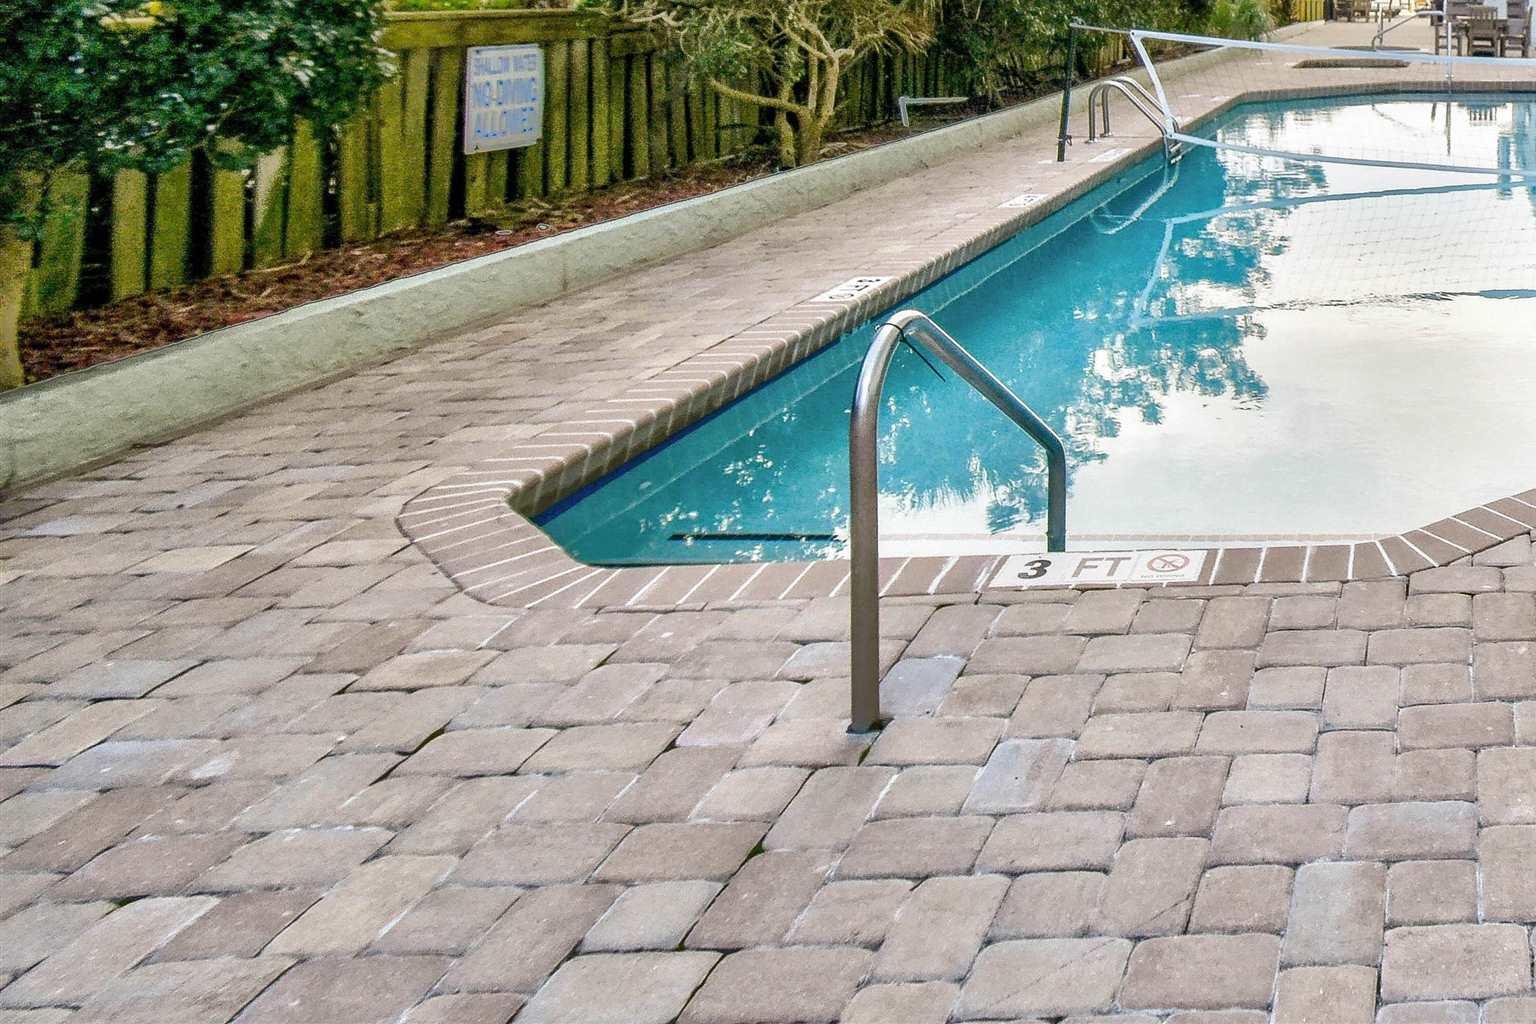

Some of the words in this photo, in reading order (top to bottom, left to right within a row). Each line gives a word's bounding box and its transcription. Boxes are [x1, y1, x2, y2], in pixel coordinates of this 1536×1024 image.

[472, 81, 490, 107] NO
[497, 76, 536, 105] DIVING
[1017, 559, 1052, 580] 3
[1071, 557, 1132, 578] FT
